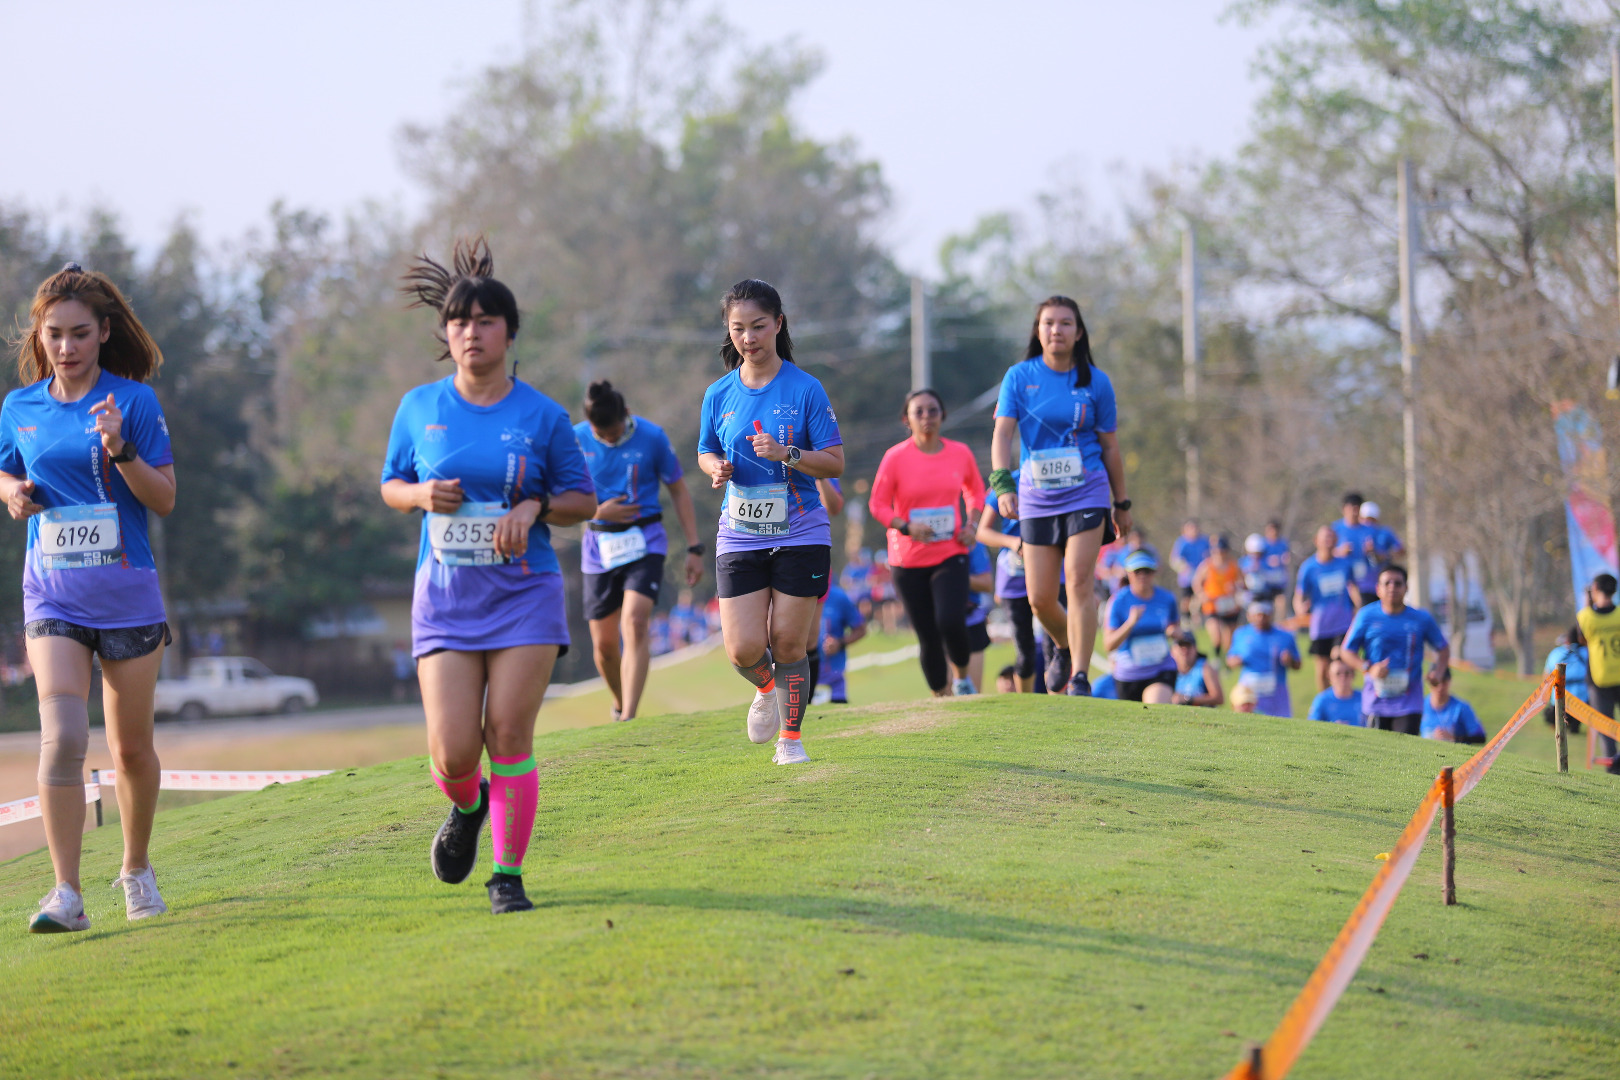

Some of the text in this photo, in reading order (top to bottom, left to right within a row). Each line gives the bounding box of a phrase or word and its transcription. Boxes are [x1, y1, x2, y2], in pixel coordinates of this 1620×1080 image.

[91, 445, 99, 476] CROSS
[1041, 460, 1071, 475] 6186
[738, 502, 774, 518] 6167
[56, 525, 100, 547] 6196
[443, 523, 496, 543] 6353
[102, 554, 113, 566] 16
[785, 674, 804, 726] kalenji
